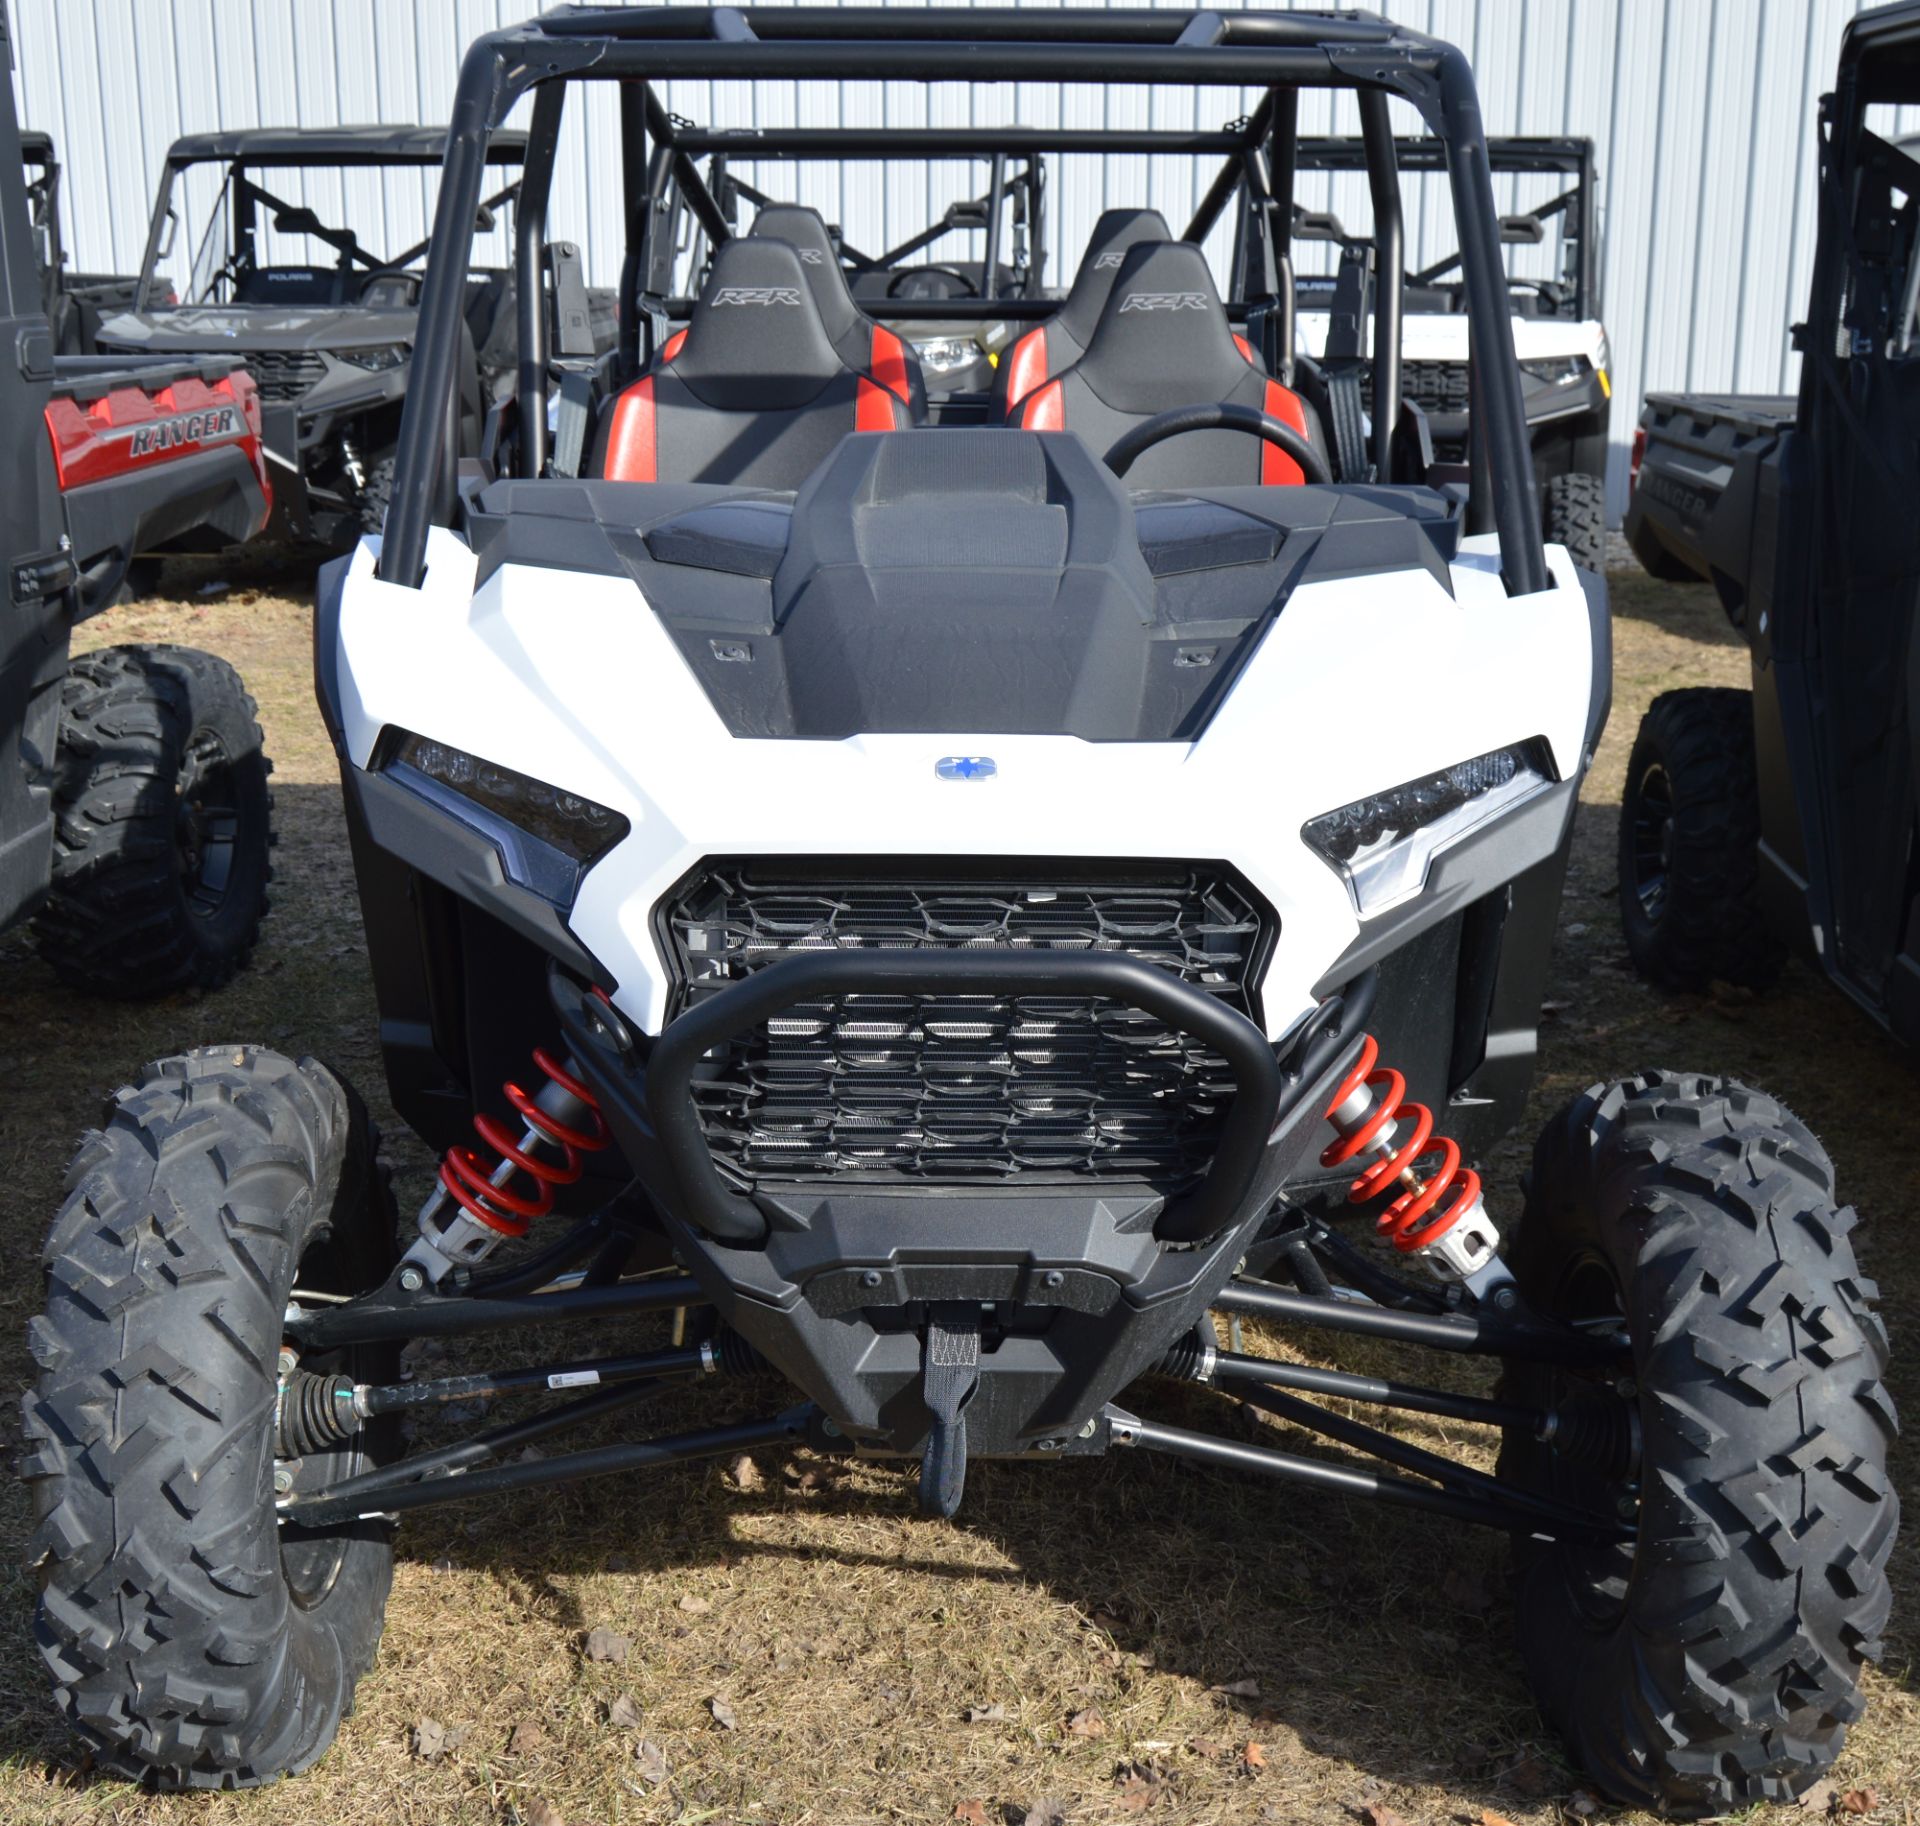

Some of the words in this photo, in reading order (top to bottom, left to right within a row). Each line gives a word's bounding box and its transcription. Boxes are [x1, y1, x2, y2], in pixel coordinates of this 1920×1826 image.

[711, 287, 801, 307] RZR
[1119, 292, 1208, 313] RZR
[129, 407, 234, 458] RANGER
